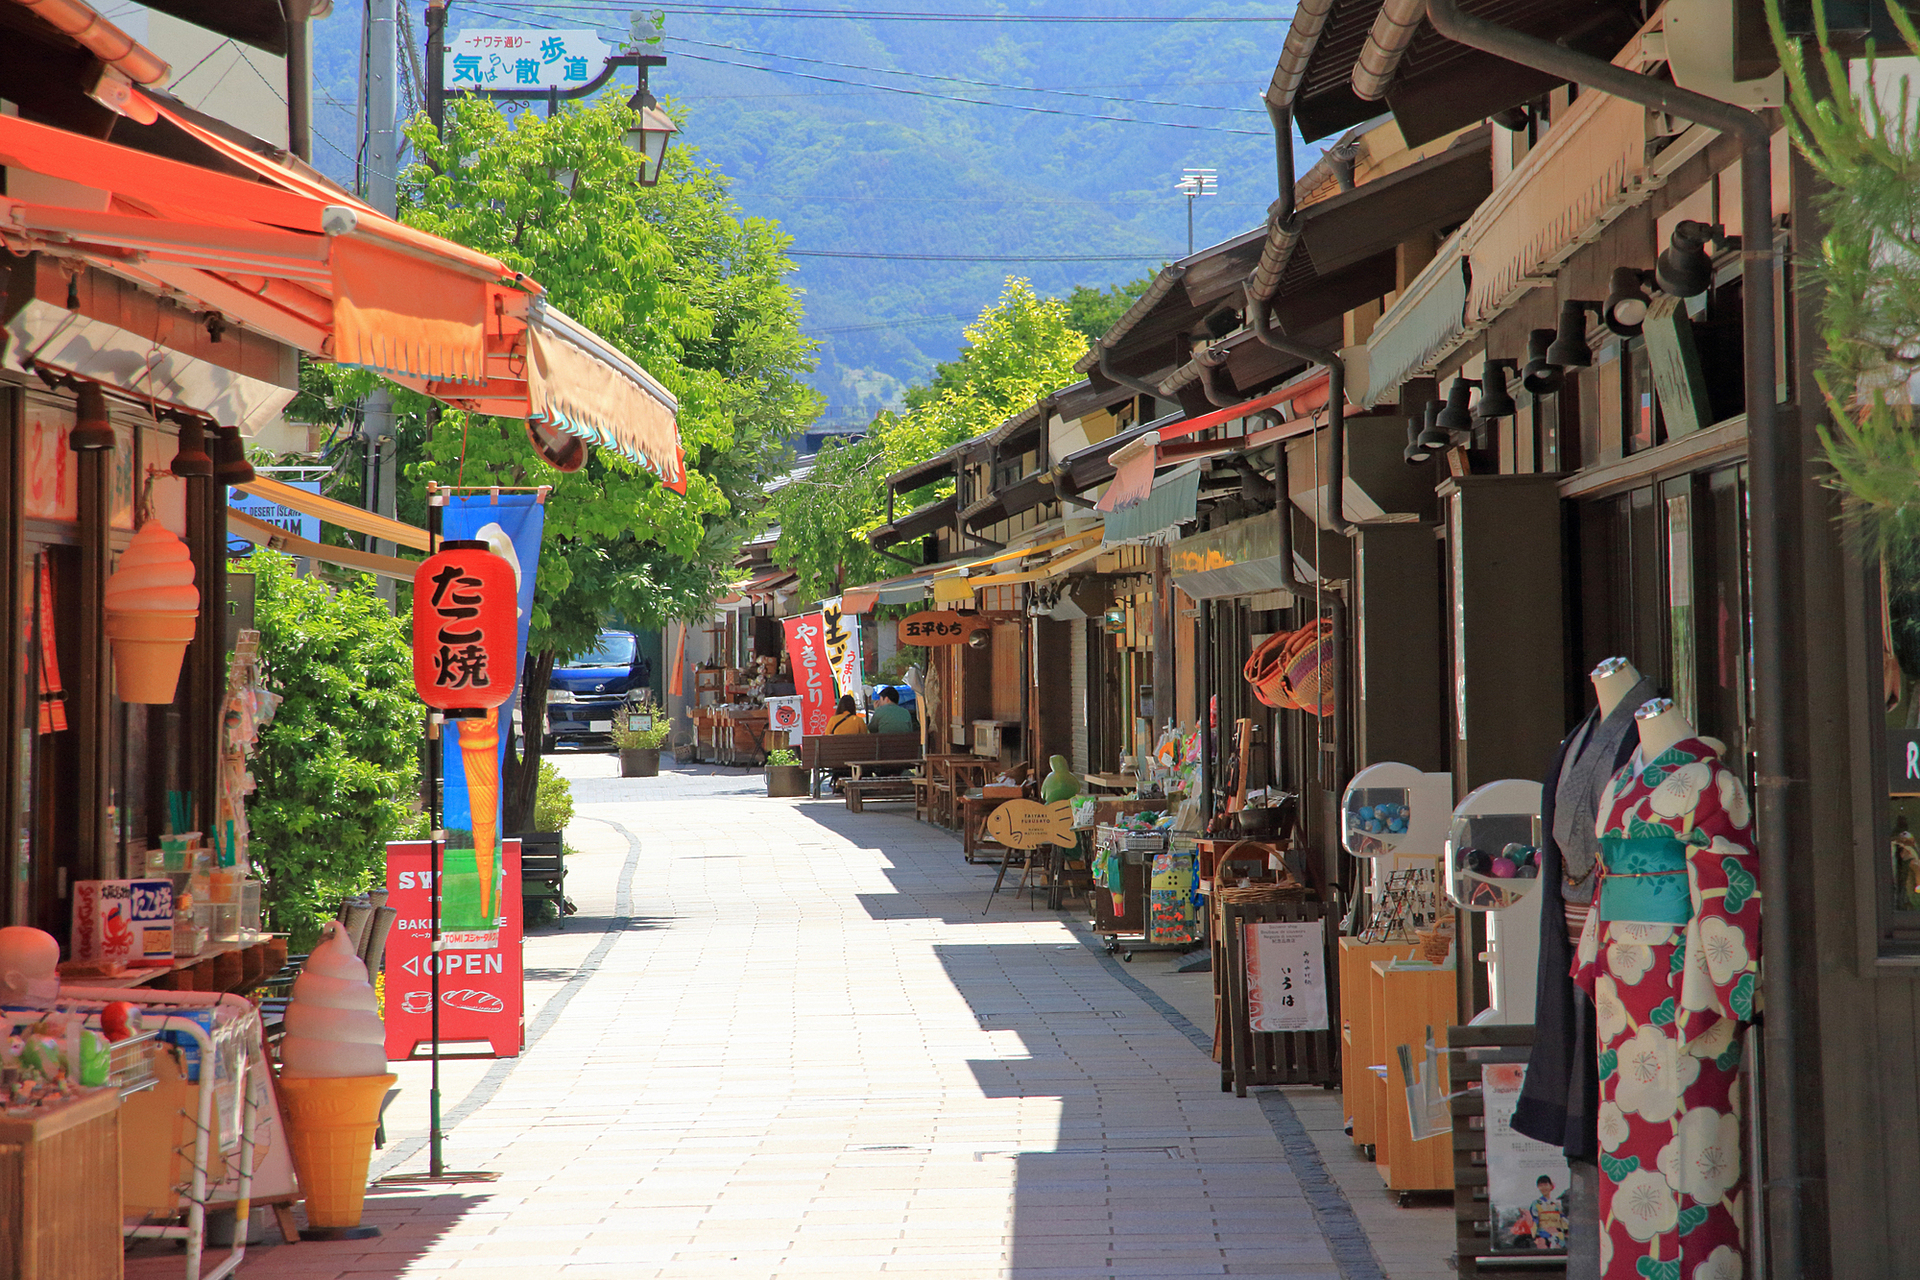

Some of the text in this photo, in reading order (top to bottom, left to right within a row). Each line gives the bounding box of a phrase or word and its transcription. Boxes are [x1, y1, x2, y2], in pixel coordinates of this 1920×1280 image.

[452, 36, 589, 84] 気ばらし散歩道
[249, 506, 275, 517] DESERT
[431, 565, 490, 689] たこ焼
[906, 621, 962, 637] 五平もち
[794, 622, 823, 708] やきとり
[445, 934, 463, 943] TOMI
[423, 953, 502, 976] OPEN
[1492, 1086, 1522, 1094] Japanes
